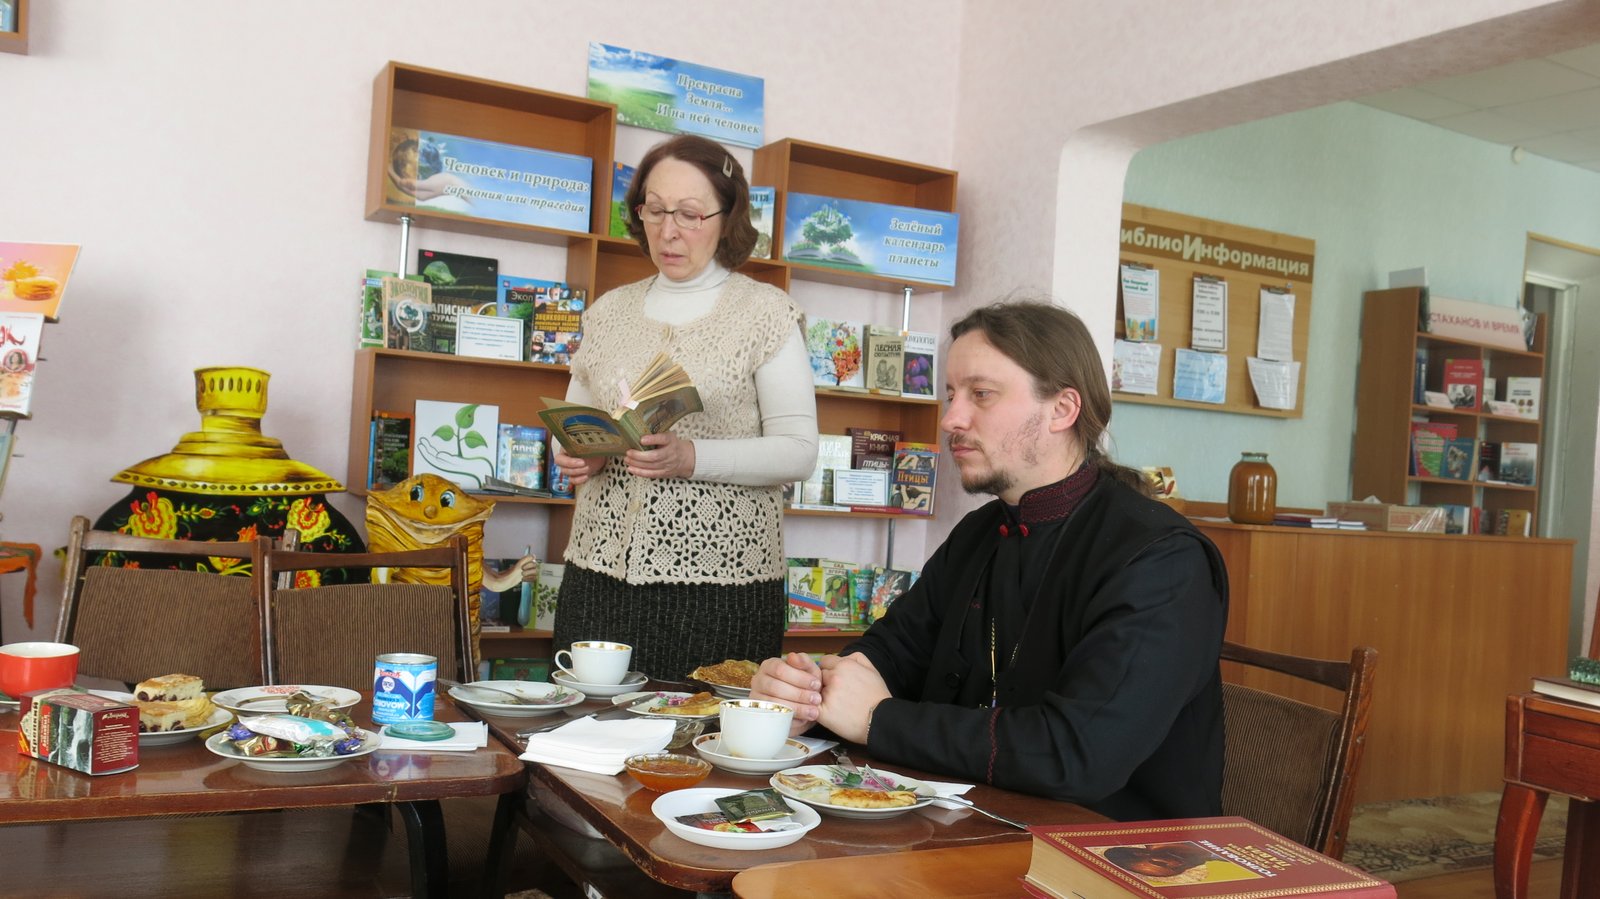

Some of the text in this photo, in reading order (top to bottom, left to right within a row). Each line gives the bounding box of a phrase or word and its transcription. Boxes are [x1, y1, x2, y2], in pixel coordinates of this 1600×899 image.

[678, 74, 742, 97] Прекрасна
[657, 104, 760, 134] И на ней человек
[444, 158, 589, 192] Человек и природа:
[445, 185, 585, 213] гармония или трагедия
[890, 218, 942, 235] Зелёный
[884, 237, 945, 253] календарь
[1120, 227, 1310, 276] иблиоИнформация
[888, 254, 940, 268] планеты
[431, 303, 471, 316] АПИСКИ
[1430, 312, 1481, 329] СТАХАНОВ
[870, 433, 900, 442] КРАСНАЯ
[897, 470, 929, 485] Птицы
